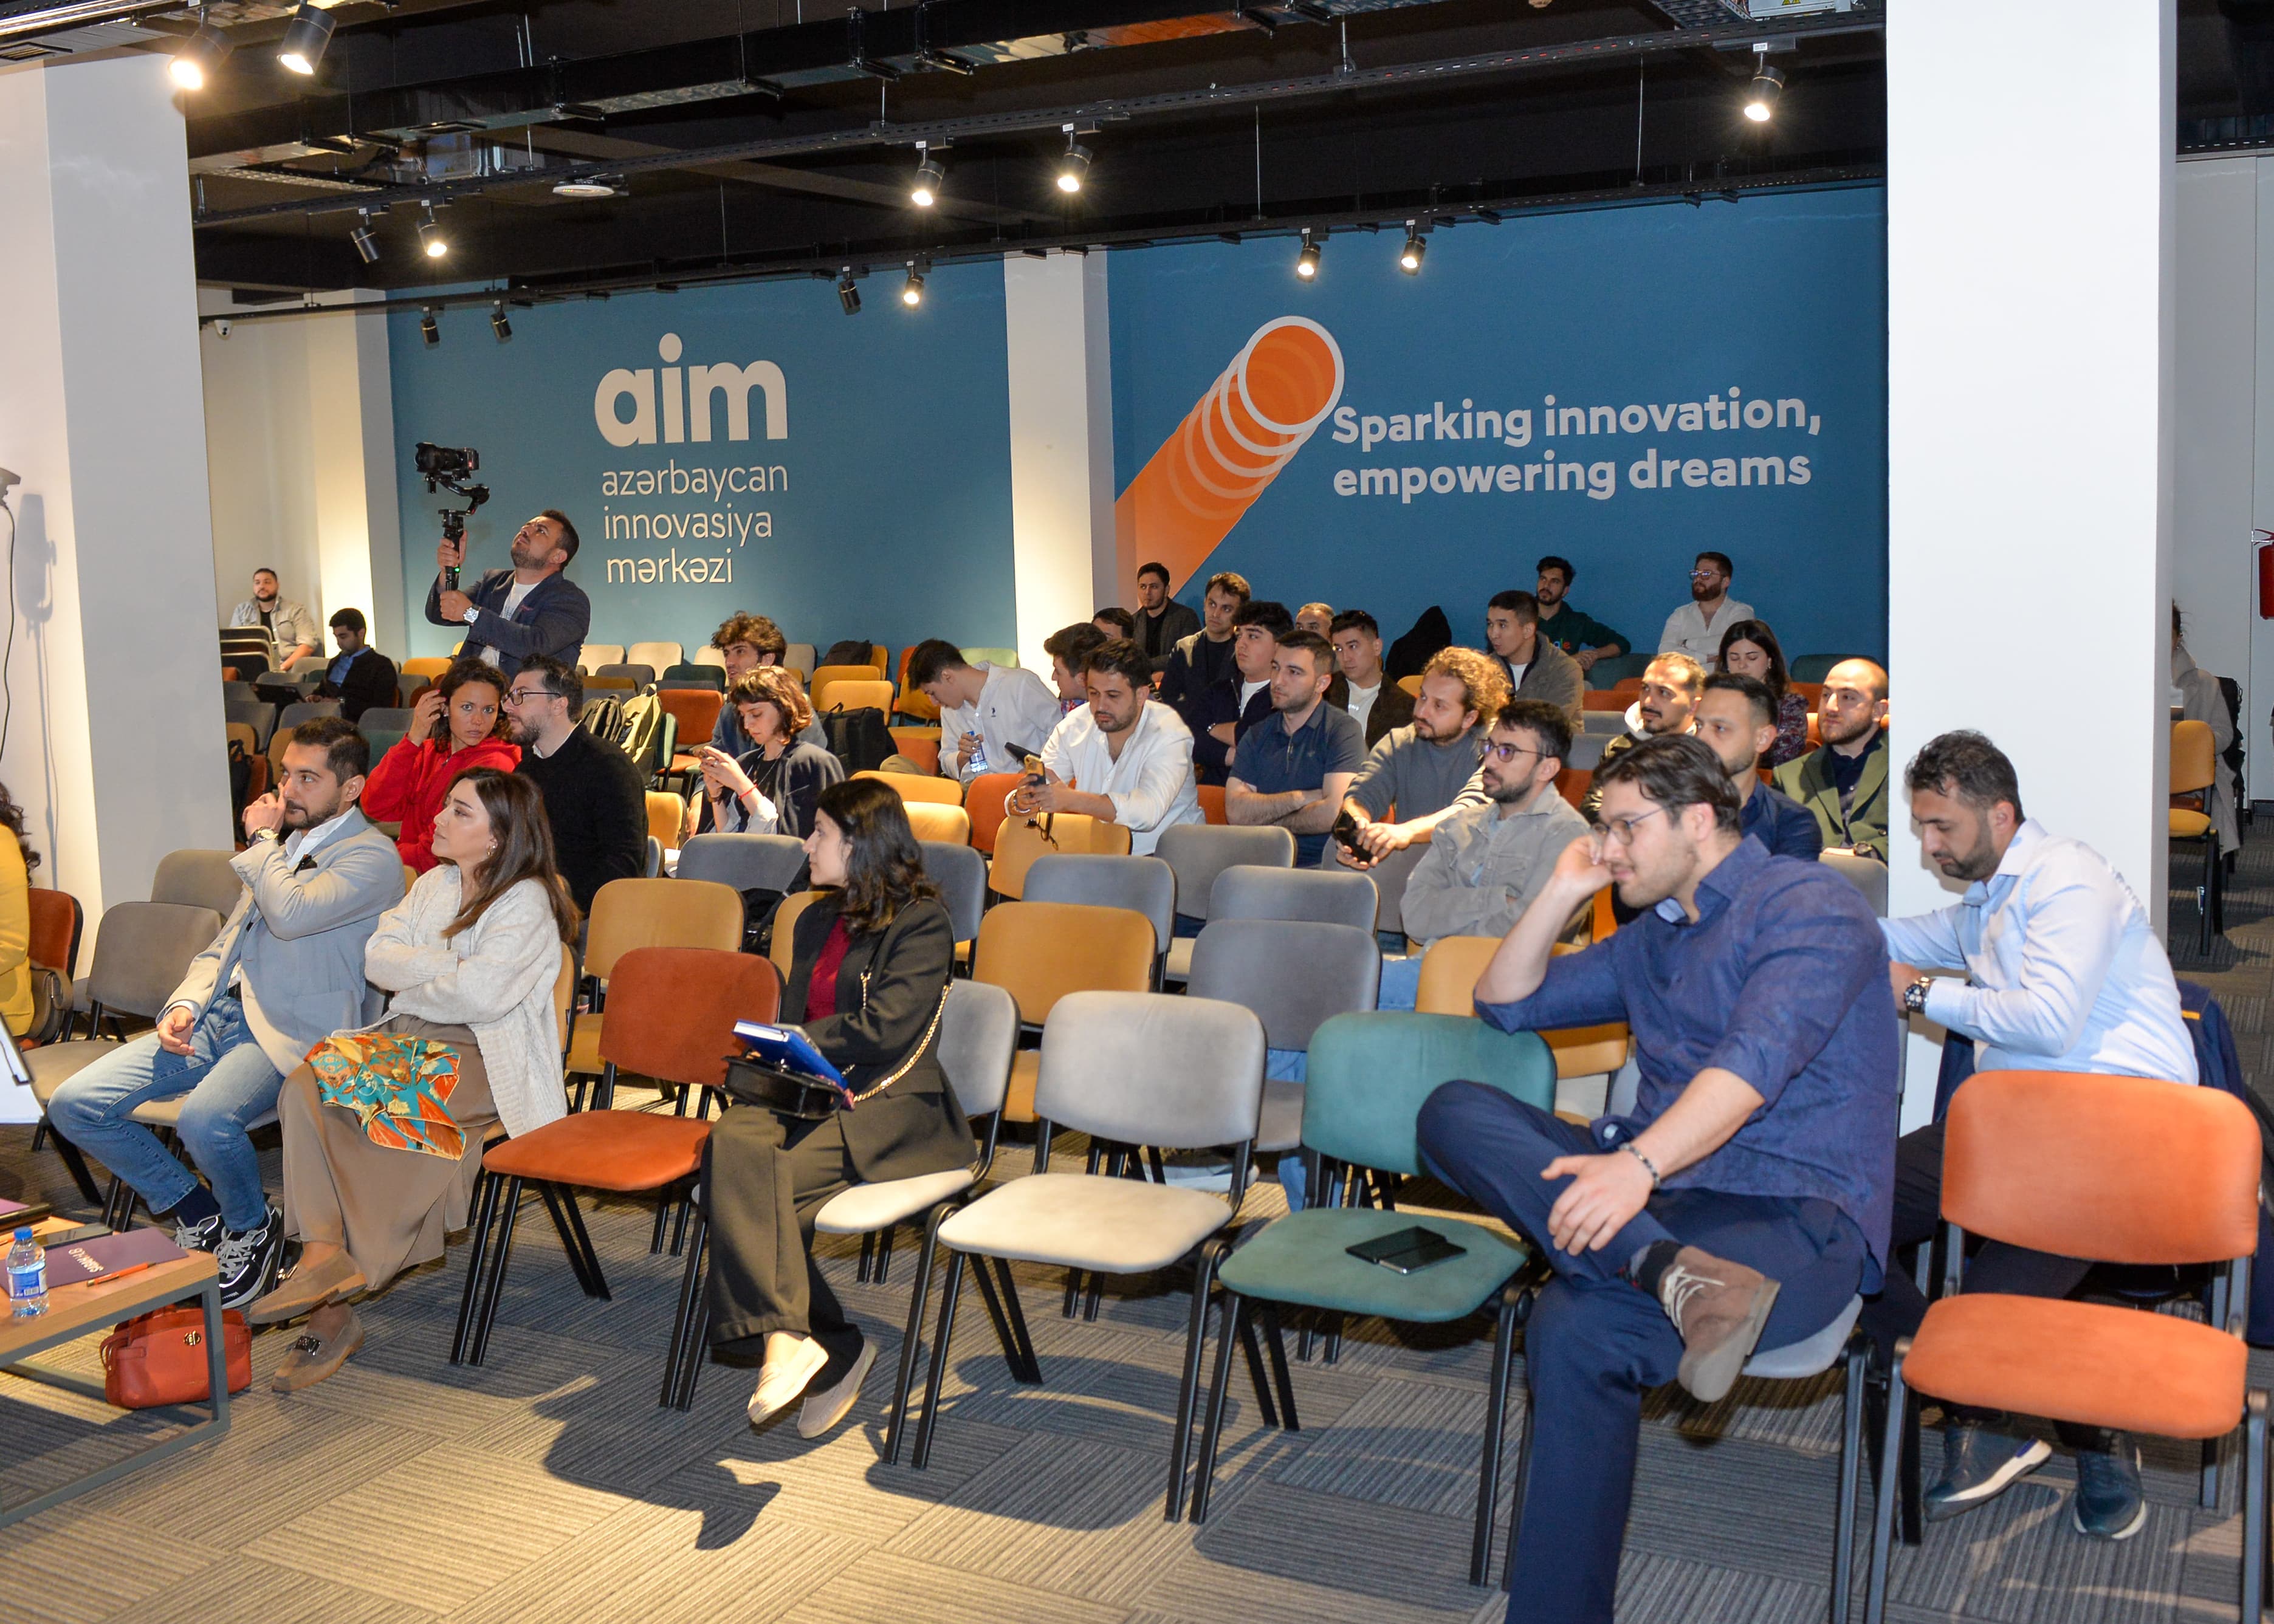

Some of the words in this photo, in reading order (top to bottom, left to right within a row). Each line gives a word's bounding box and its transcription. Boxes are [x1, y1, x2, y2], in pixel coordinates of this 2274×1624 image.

[594, 332, 788, 448] aim
[1331, 398, 1532, 453] Sparking
[1545, 386, 1820, 436] innovation,
[602, 459, 788, 502] azərbaycan
[1333, 449, 1616, 504] empowering
[1629, 448, 1812, 489] dreams
[603, 502, 772, 547] innovasiya
[606, 547, 733, 584] mərkəzi
